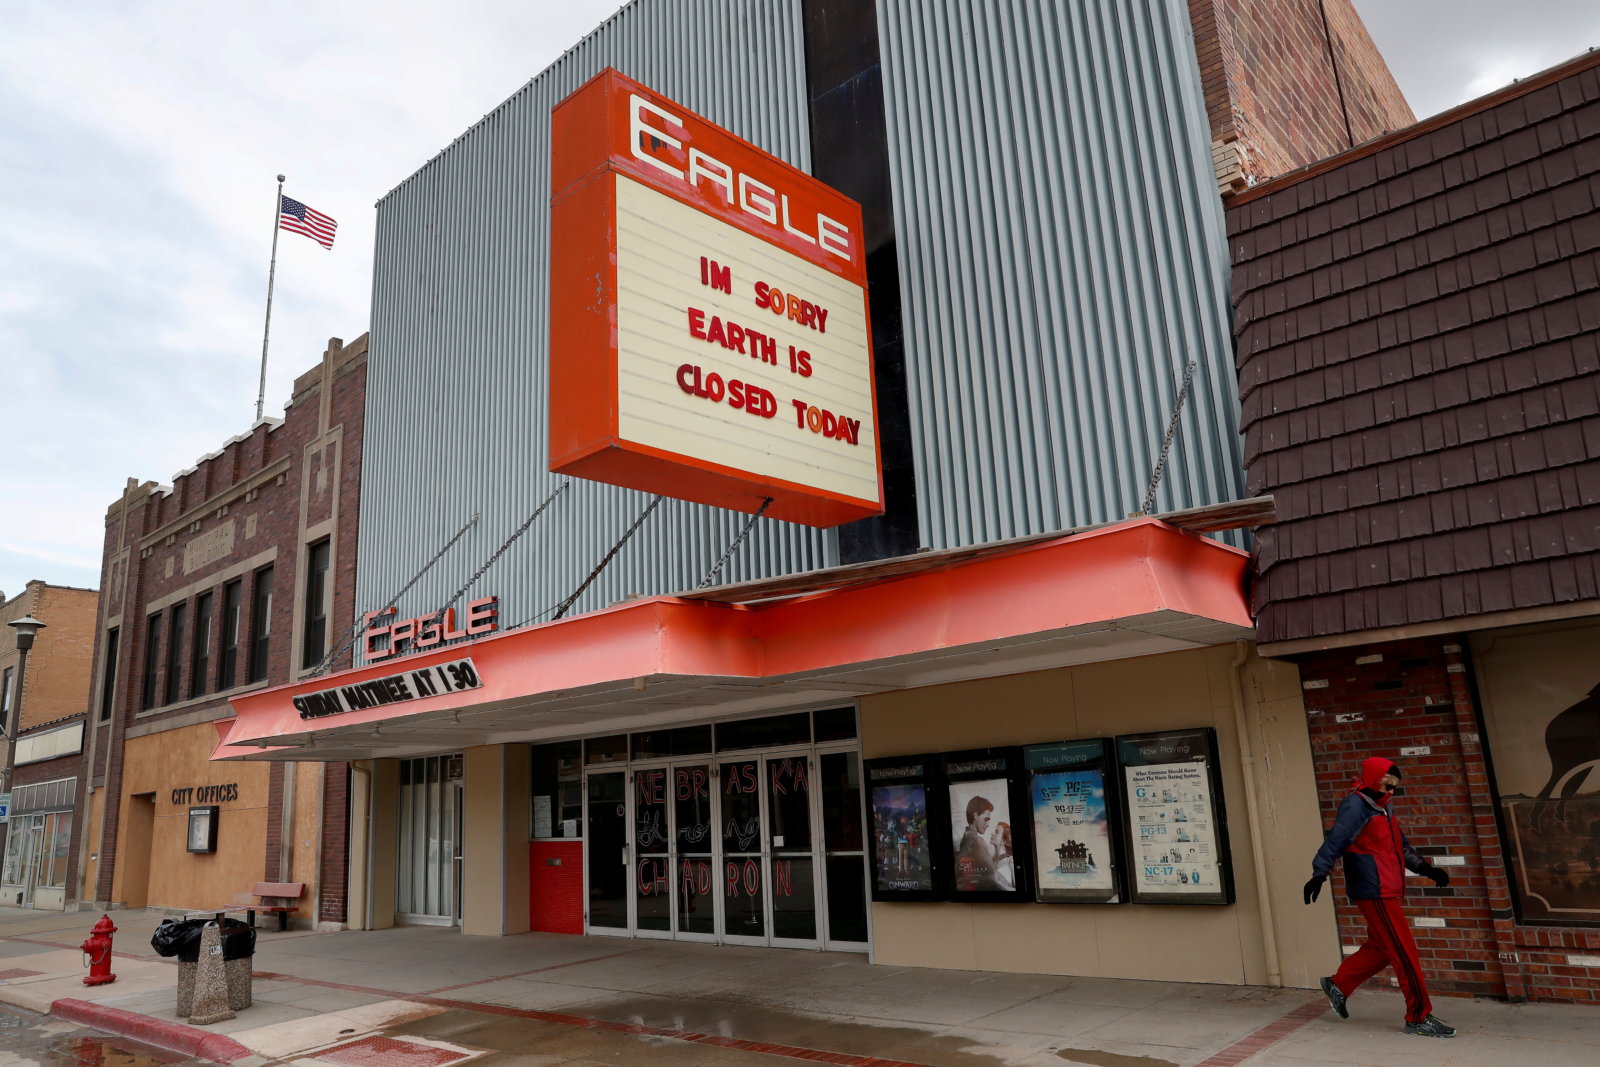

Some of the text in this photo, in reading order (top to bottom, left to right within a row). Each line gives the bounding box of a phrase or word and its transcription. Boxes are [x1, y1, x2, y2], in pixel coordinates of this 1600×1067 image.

[629, 94, 851, 261] EAGLE
[700, 256, 828, 333] IM SORRY
[687, 307, 813, 378] EARTH IS
[676, 363, 860, 446] CLOSED TODAY
[189, 528, 229, 551] MUNICIPAL
[363, 596, 499, 660] EAGLE
[293, 690, 345, 719] SUNDAY
[341, 676, 413, 711] MATINEE
[412, 669, 437, 697] AT
[1043, 753, 1087, 763] Now Playing
[1160, 745, 1190, 754] Playing
[172, 783, 239, 806] CITY OFFICES
[1041, 788, 1050, 798] G
[1066, 782, 1080, 793] PG
[1136, 788, 1147, 798] G
[1054, 805, 1075, 813] PG-13
[1140, 827, 1167, 835] PG-13
[637, 858, 791, 897] CHADRON
[1144, 866, 1173, 876] NC-17
[889, 881, 919, 889] ONWARD
